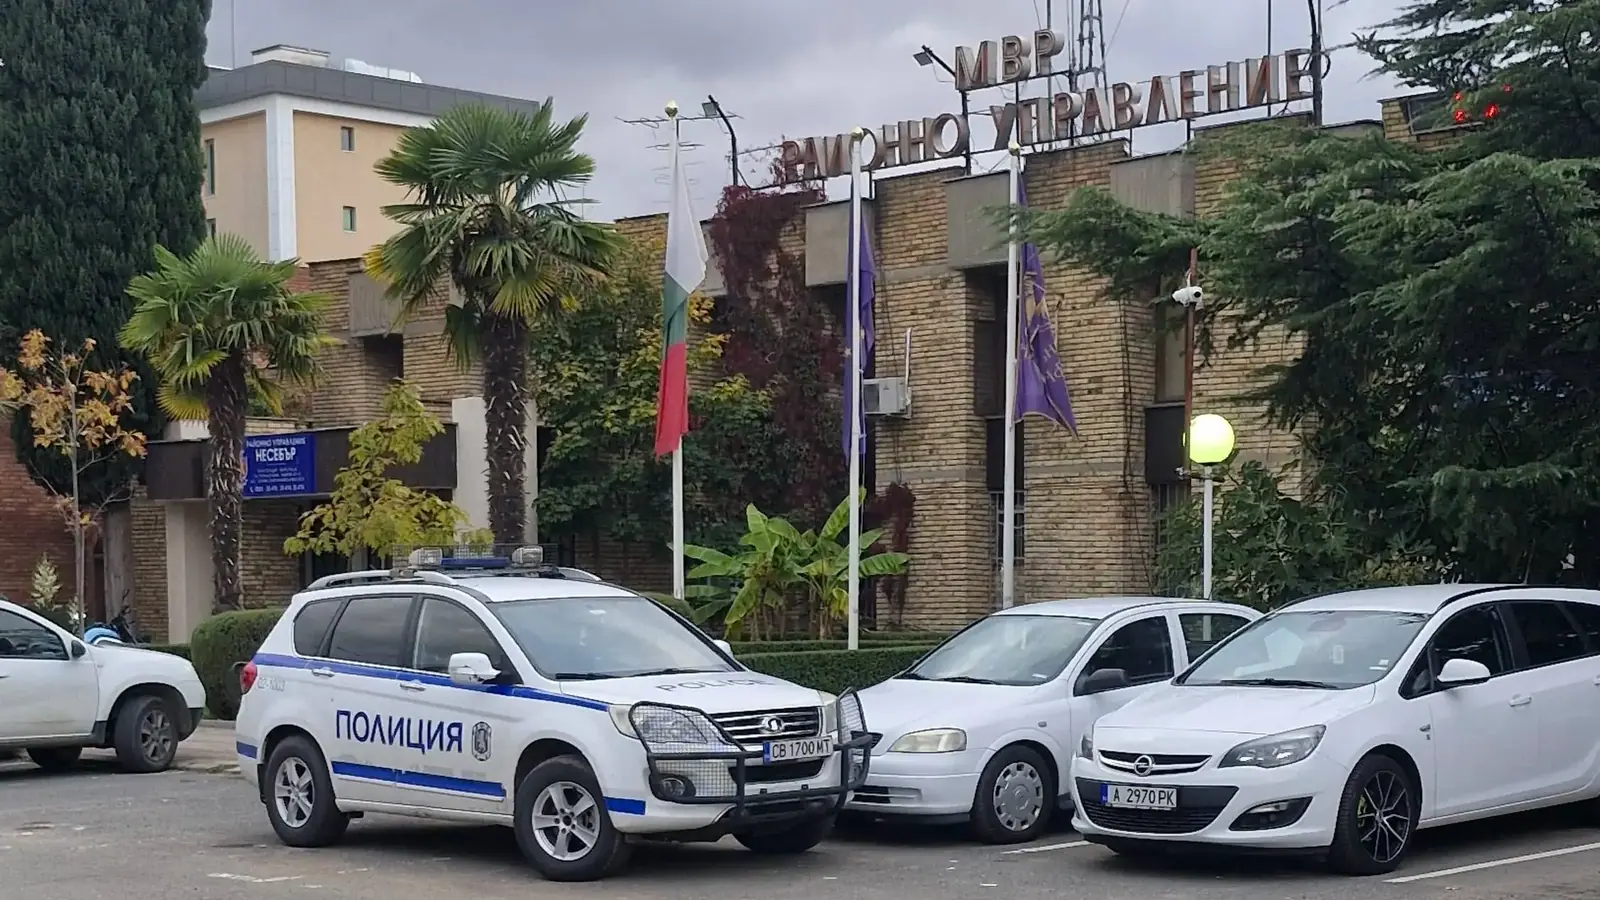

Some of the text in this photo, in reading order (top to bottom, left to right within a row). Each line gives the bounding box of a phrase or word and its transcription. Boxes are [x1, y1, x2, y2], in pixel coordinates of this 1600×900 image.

[955, 28, 1064, 91] МВР
[989, 48, 1313, 150] УПРАВЛЕНИЕ
[255, 446, 296, 462] НЕСЕБЪР
[655, 679, 777, 692] POLICE
[336, 709, 463, 755] ПОЛИЦИЯ
[789, 740, 815, 757] 1700
[1126, 789, 1156, 805] 2970
